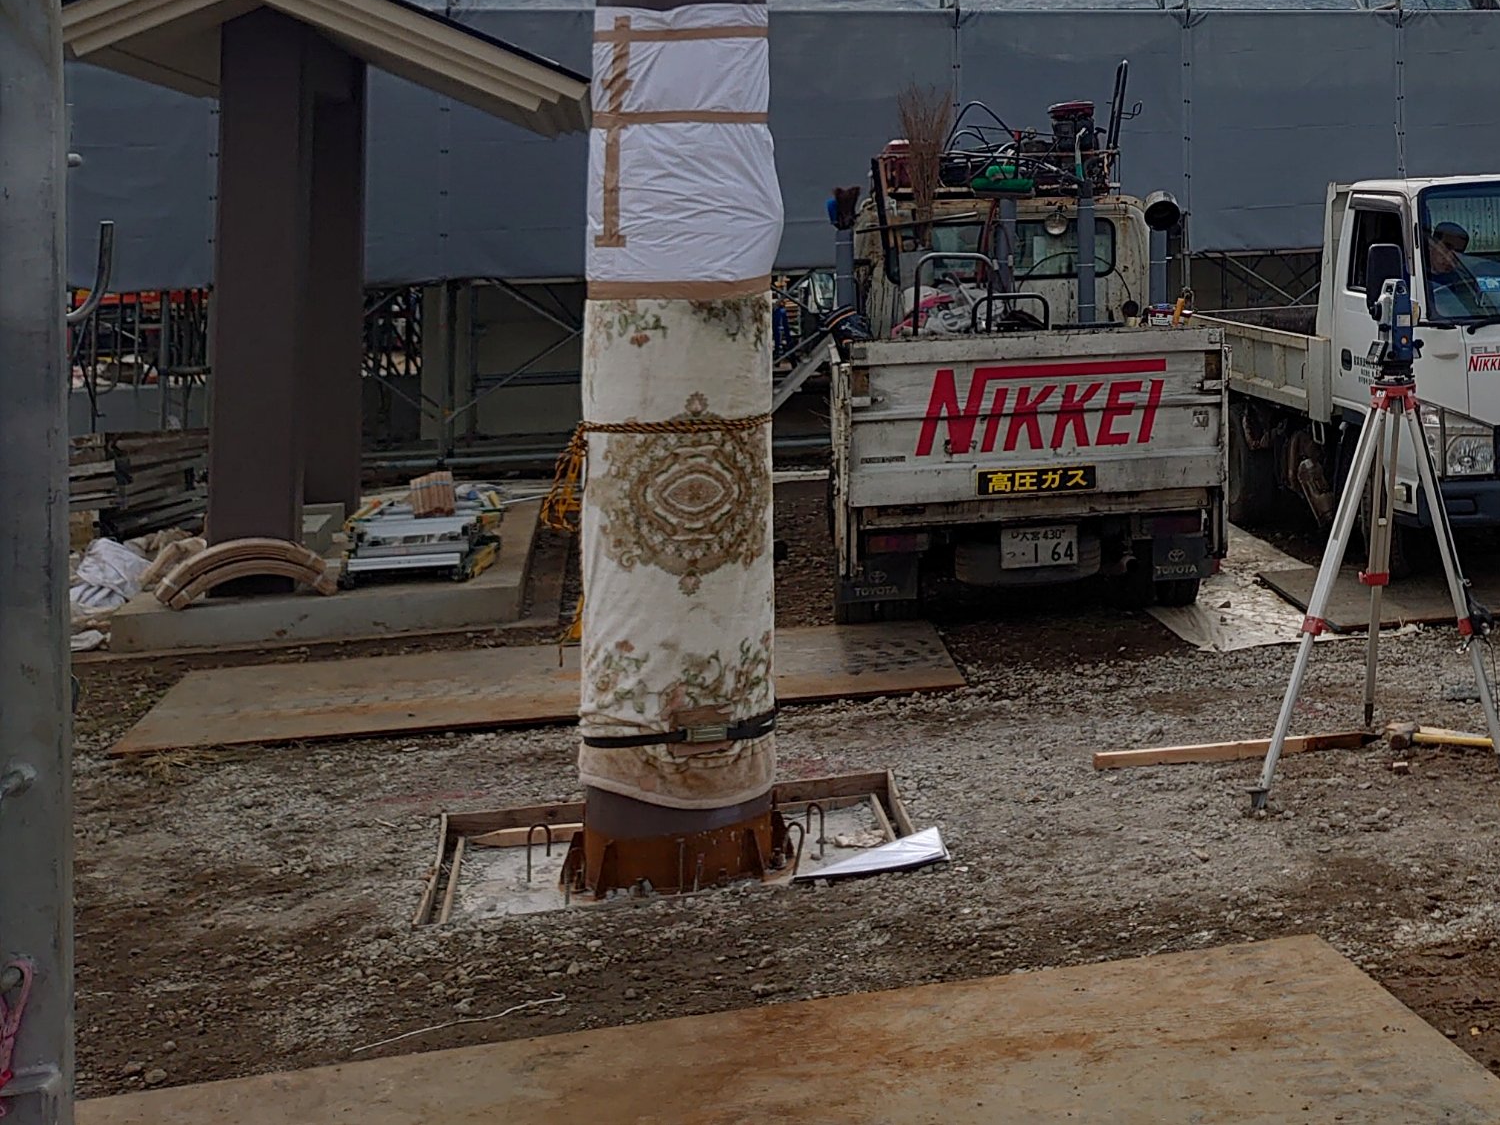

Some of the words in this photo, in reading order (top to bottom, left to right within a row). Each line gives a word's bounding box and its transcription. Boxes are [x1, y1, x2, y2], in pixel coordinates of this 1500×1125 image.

[914, 358, 1167, 457] NIKKEI
[987, 469, 1088, 494] 高圧ガス
[1042, 528, 1062, 541] 430
[1154, 564, 1198, 575] TOYOTA
[854, 586, 899, 597] TOYOTA
